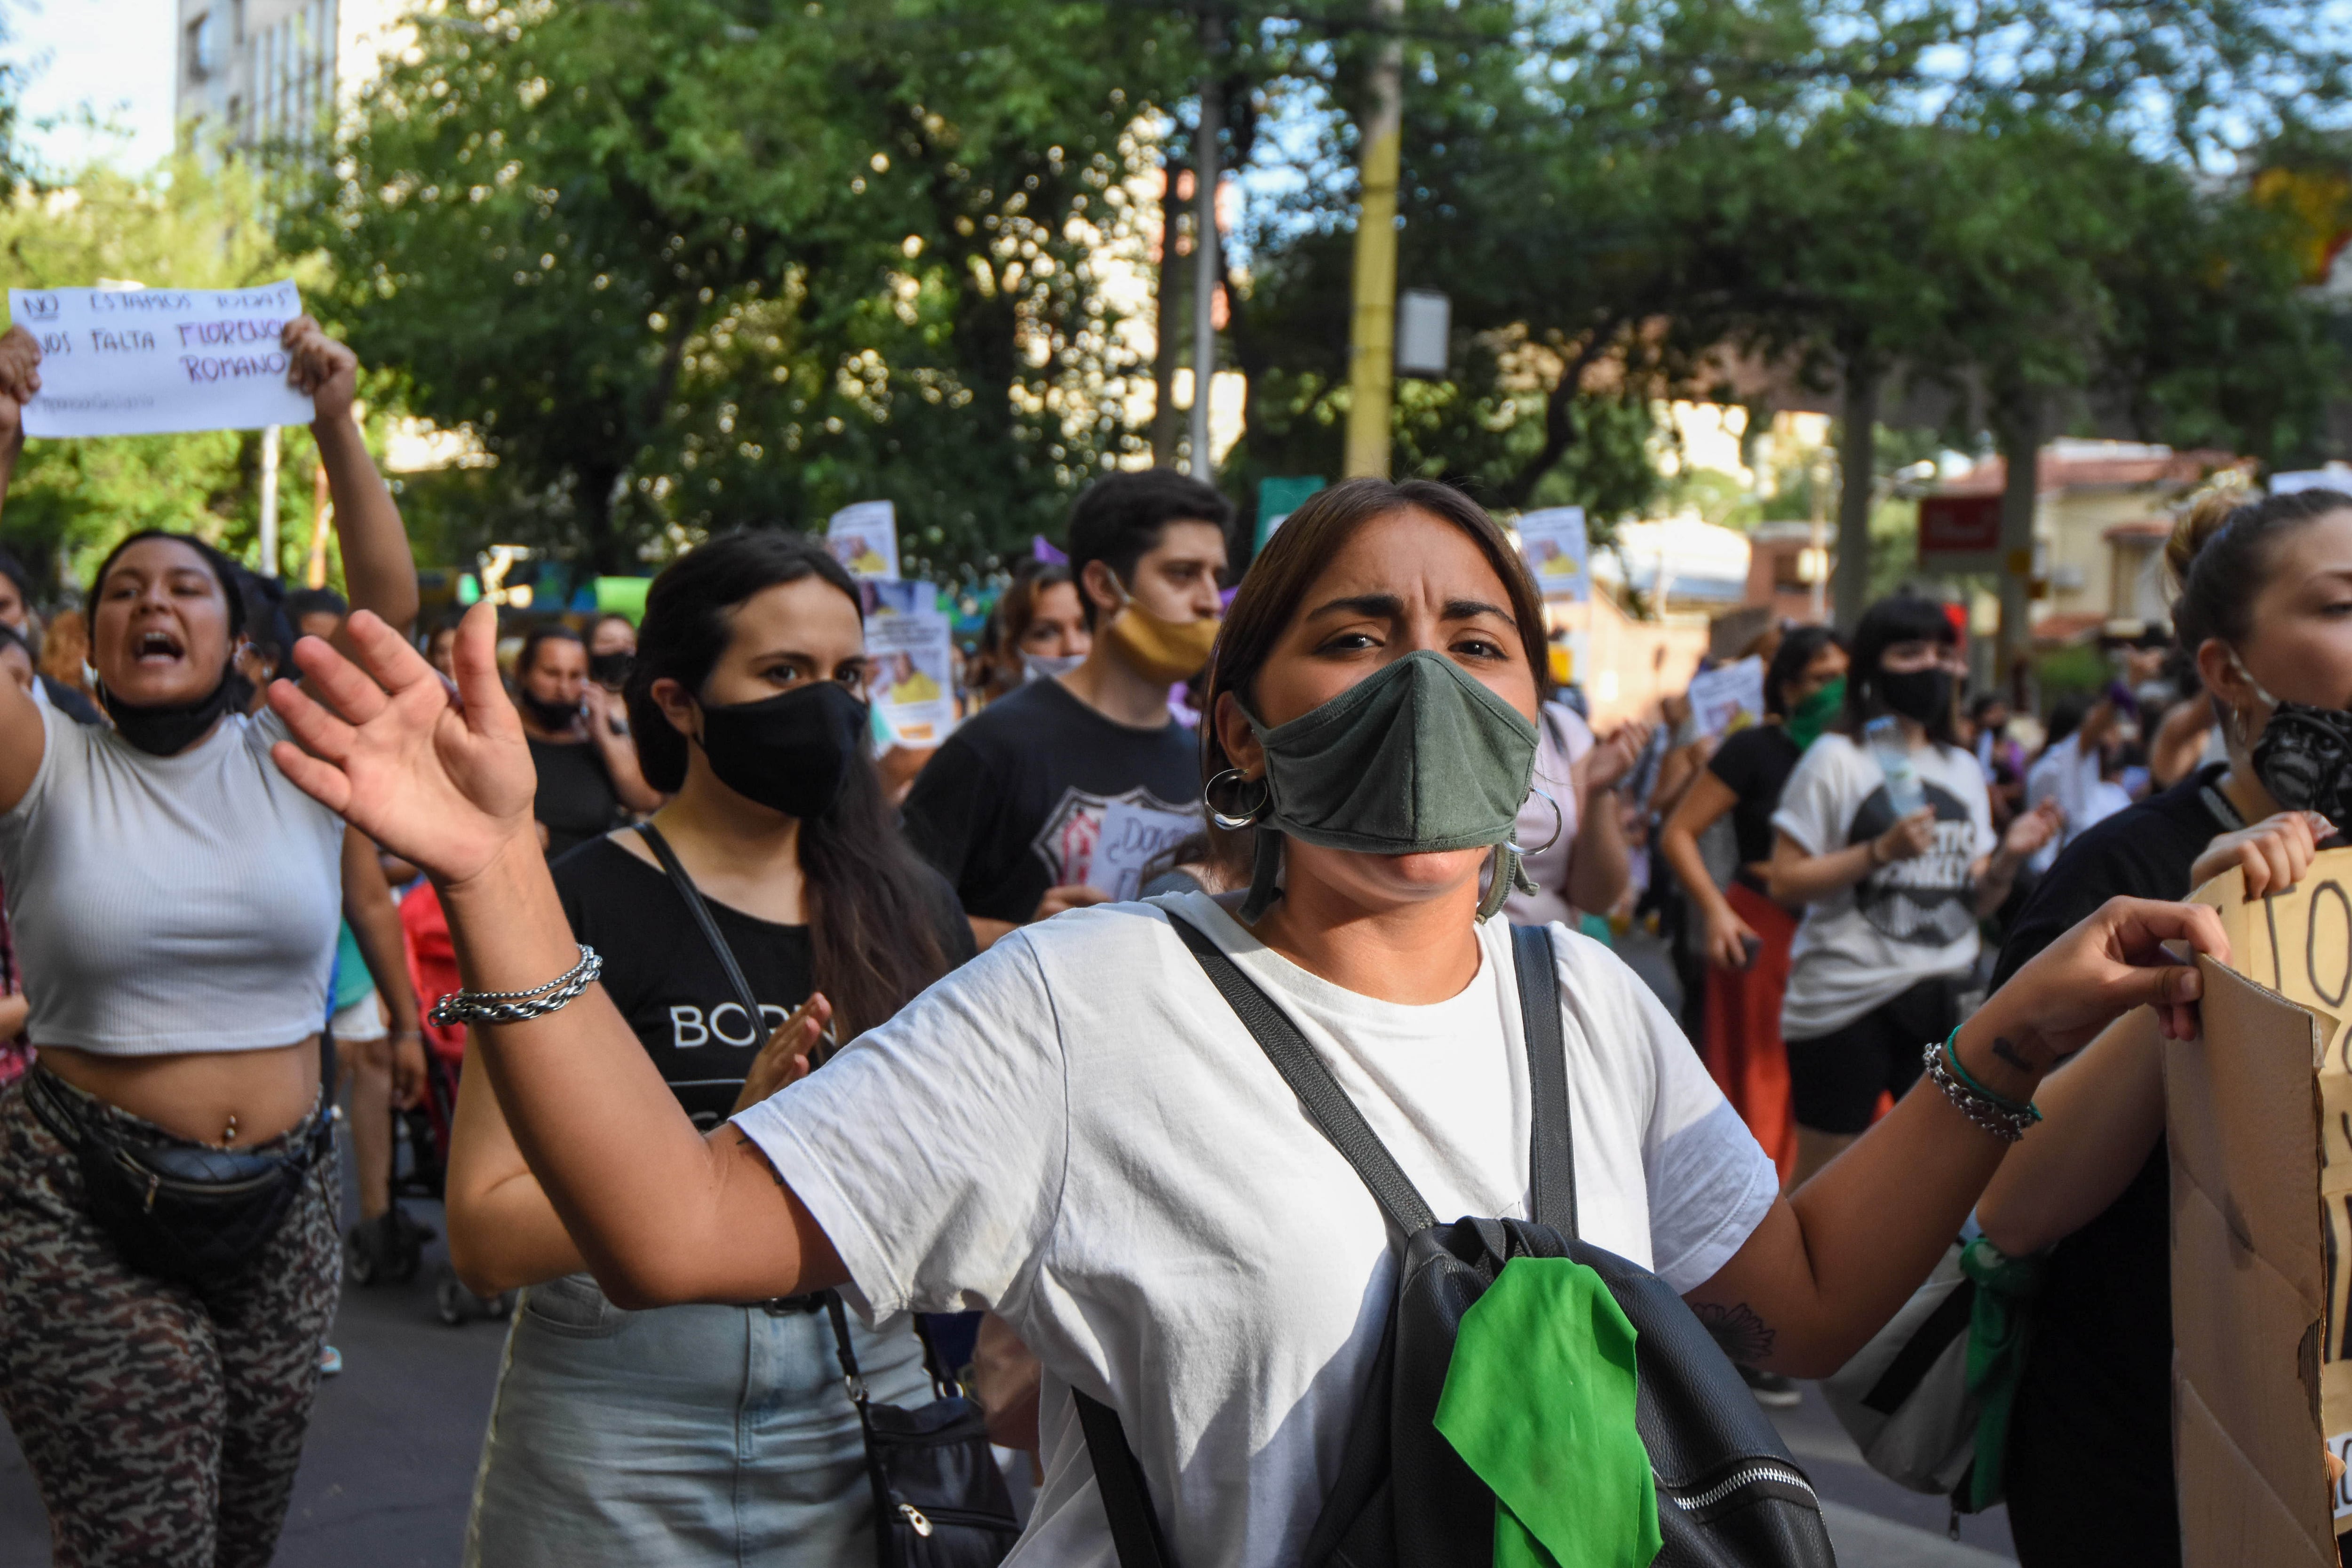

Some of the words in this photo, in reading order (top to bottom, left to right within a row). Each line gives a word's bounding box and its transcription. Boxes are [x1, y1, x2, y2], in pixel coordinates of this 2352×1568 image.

[23, 294, 59, 316] NO
[90, 292, 191, 310] ESTAMOS
[39, 330, 71, 354] NOS
[90, 328, 155, 352] FALTA
[179, 352, 286, 382] ROMANO
